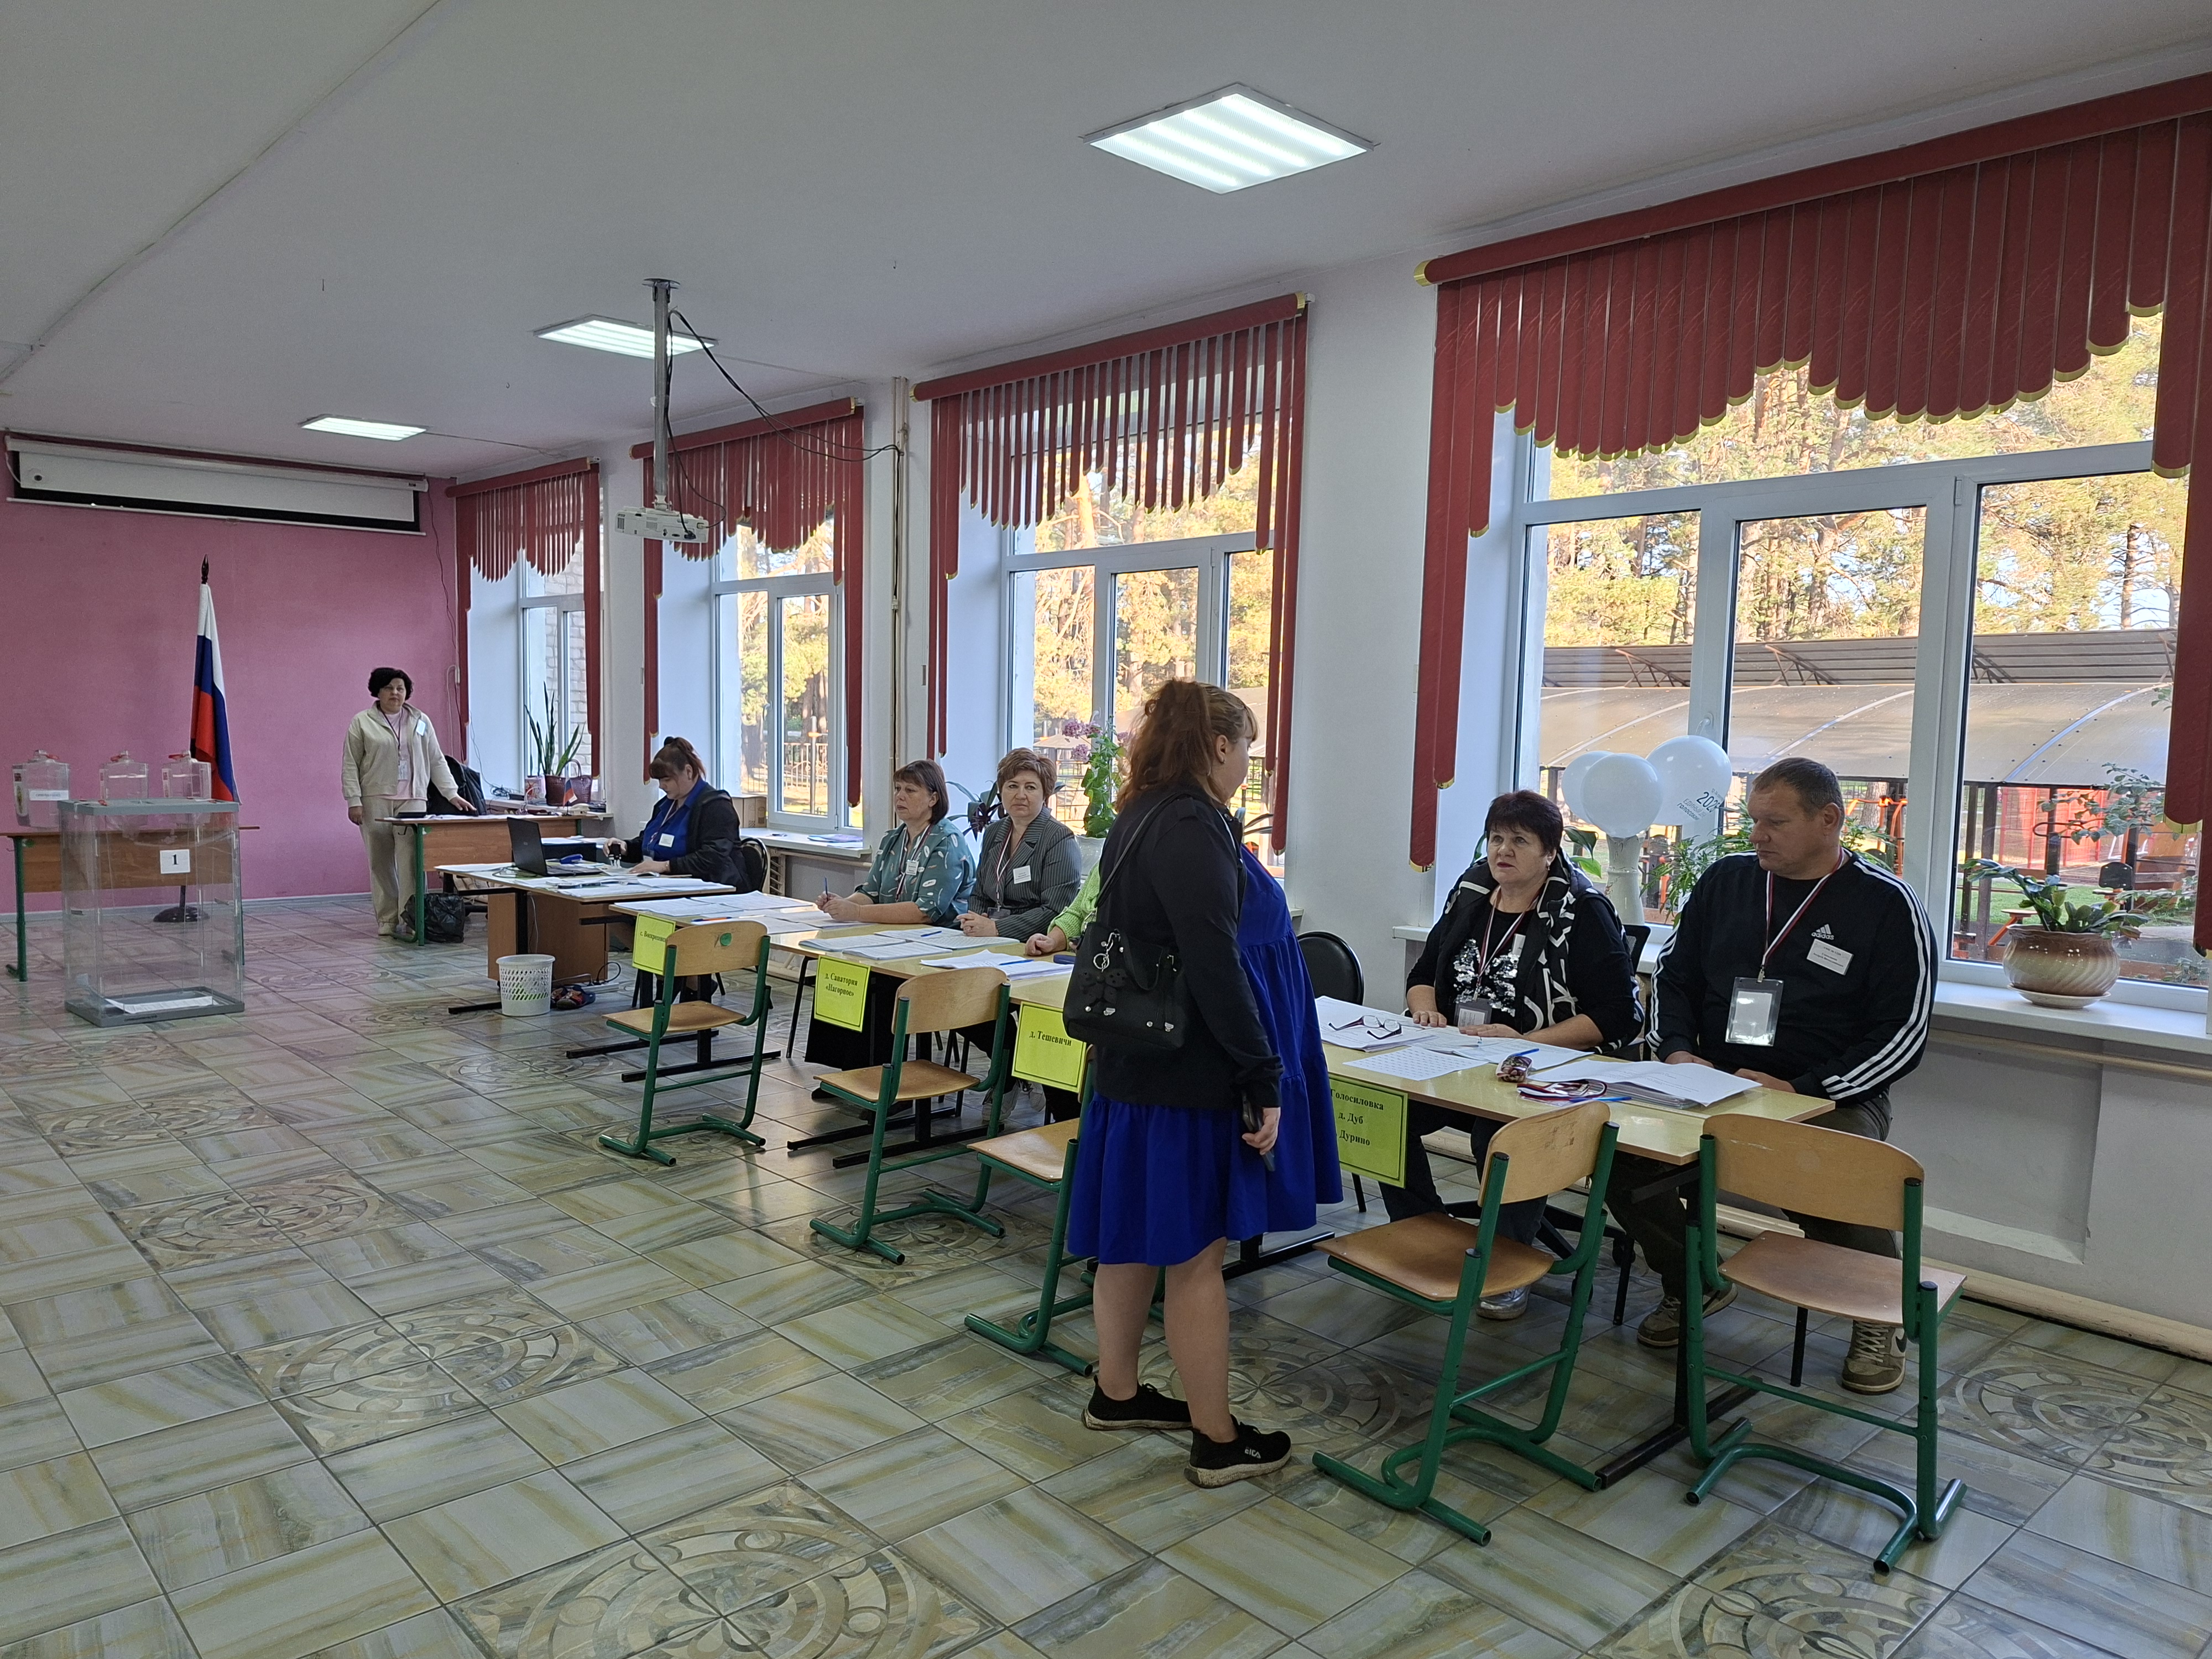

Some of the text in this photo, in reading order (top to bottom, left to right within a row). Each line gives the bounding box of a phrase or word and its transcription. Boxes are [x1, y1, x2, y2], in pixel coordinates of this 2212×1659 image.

[172, 854, 179, 865] 1
[1811, 932, 1834, 940] adidas
[831, 973, 858, 986] Санатория
[826, 983, 854, 997] «Нагорное»
[1037, 1030, 1072, 1046] Тешевичи
[1331, 1089, 1384, 1110] Голосиловка
[1338, 1112, 1364, 1125] д. Дуб
[1339, 1130, 1370, 1146] Дурино
